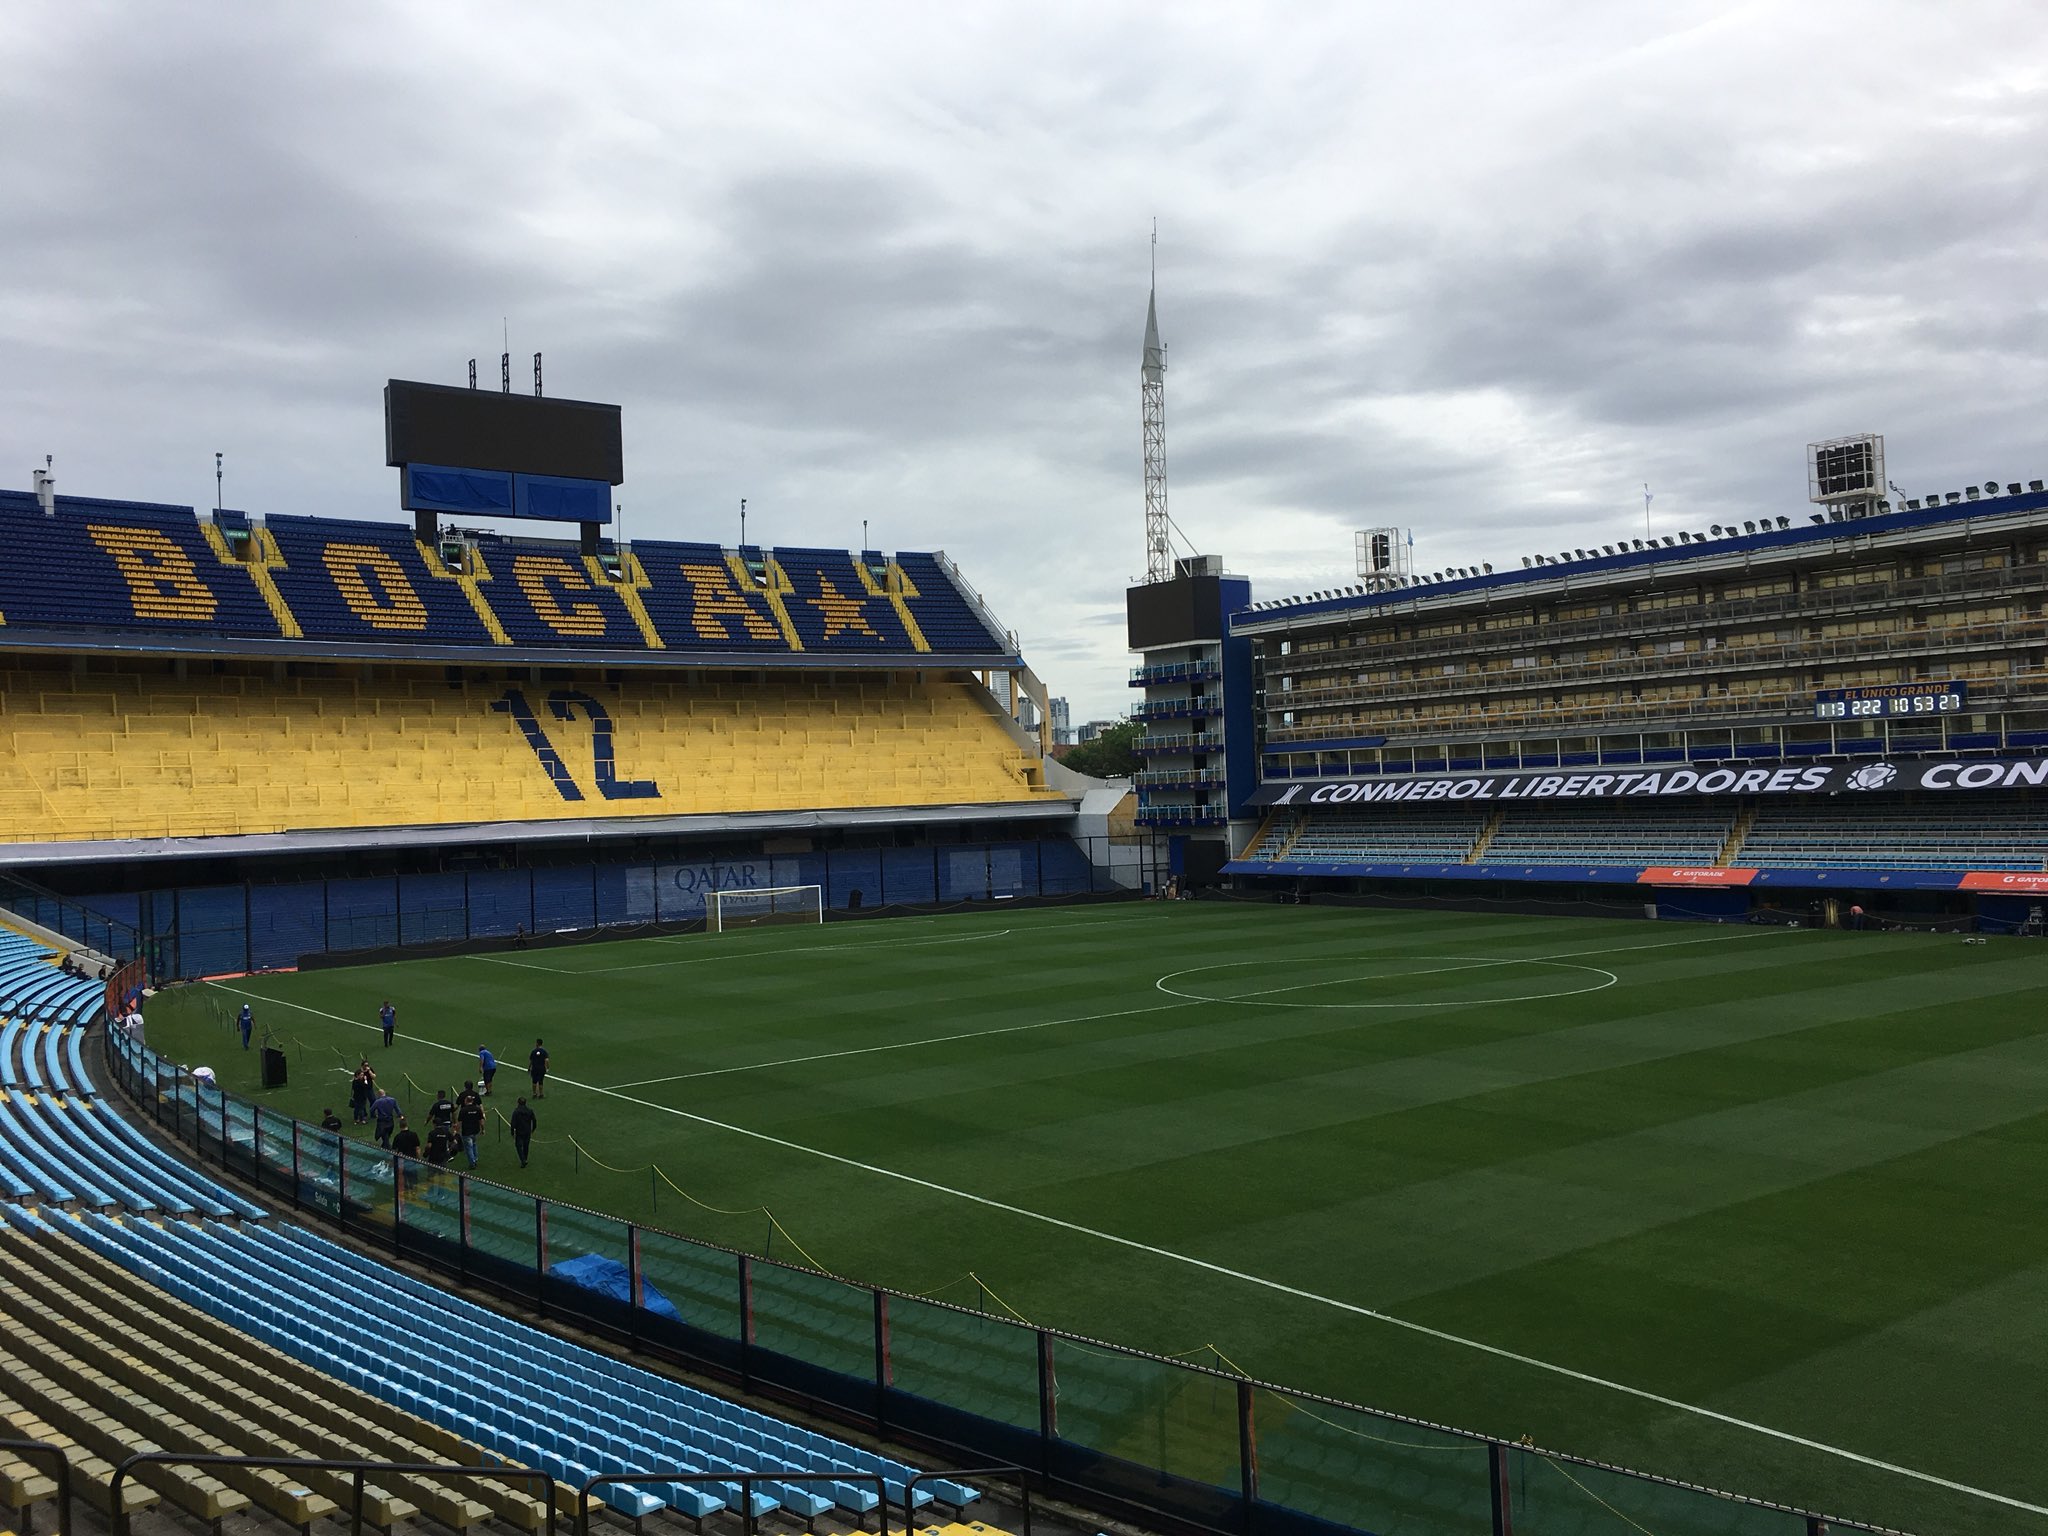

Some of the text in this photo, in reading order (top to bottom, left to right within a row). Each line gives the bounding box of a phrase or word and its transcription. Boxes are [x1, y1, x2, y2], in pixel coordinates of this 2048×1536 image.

[86, 523, 780, 640] BOCA
[1821, 694, 1960, 717] 113 222 10 53 27
[1845, 684, 1950, 700] EL ÚNICO GRANDE
[490, 688, 662, 801] 12
[1310, 766, 1833, 803] CONMEBOL LIBERTADORES
[674, 864, 758, 893] QATAR
